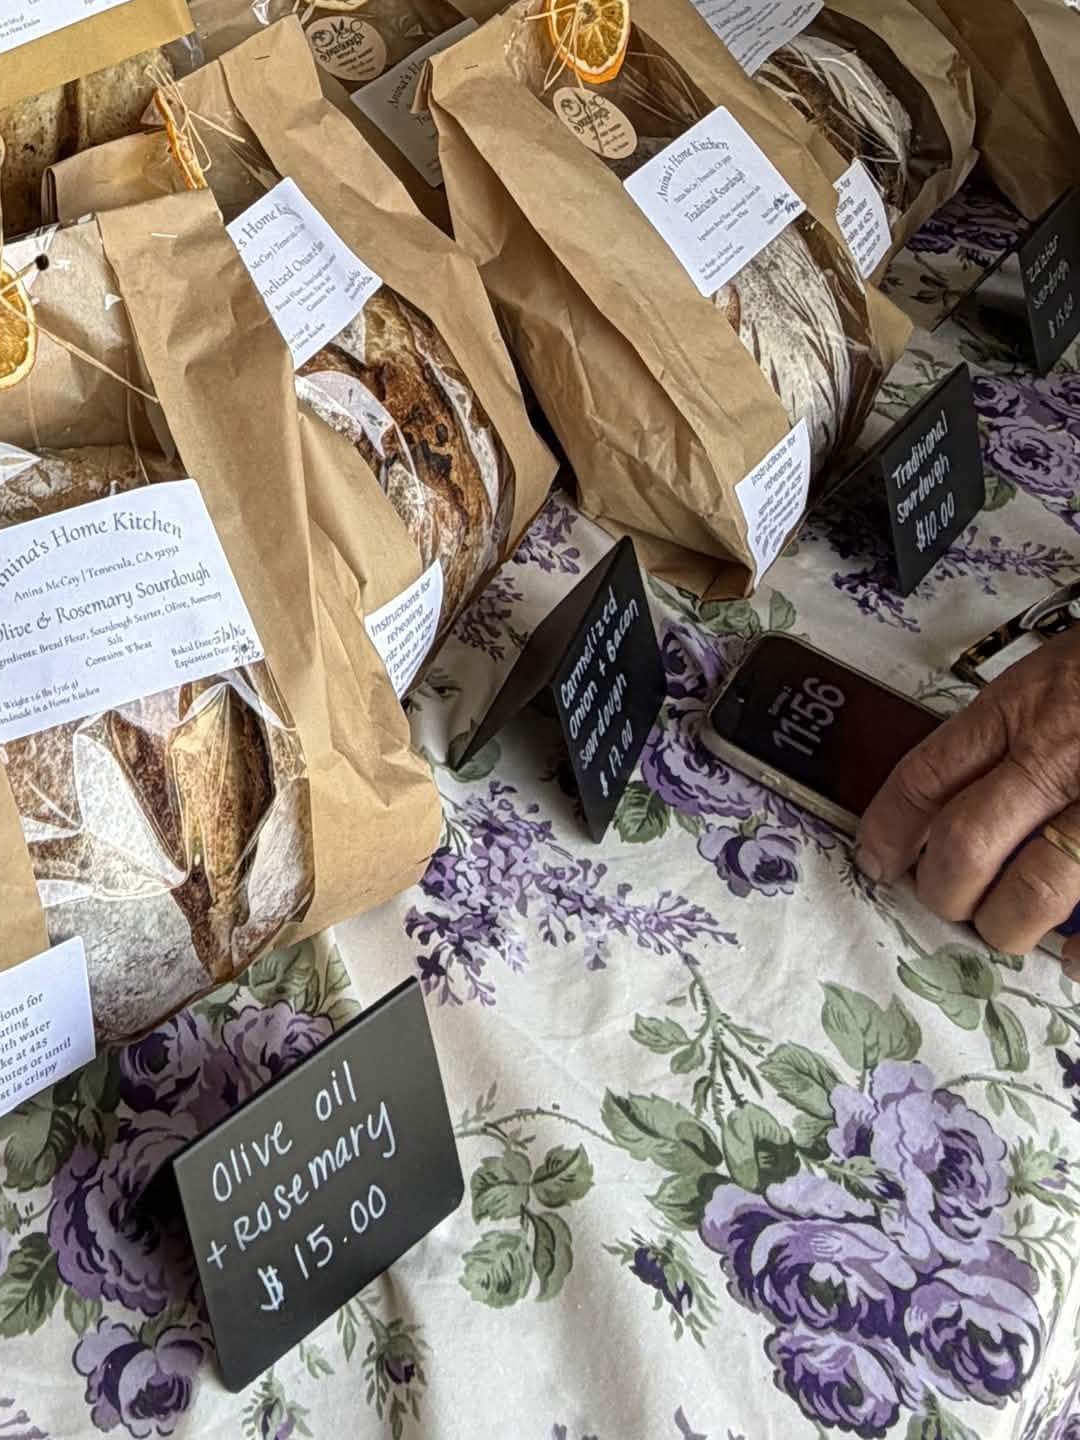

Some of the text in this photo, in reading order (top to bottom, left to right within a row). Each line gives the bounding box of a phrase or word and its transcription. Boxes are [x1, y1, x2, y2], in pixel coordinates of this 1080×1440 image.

[241, 211, 278, 240] Home
[891, 408, 949, 489] Traditional
[50, 519, 108, 548] Home
[113, 510, 183, 539] Kitchen
[14, 586, 44, 603] Anina
[45, 575, 80, 594] McCoy
[135, 551, 154, 565] CA
[36, 611, 52, 630] &
[56, 589, 133, 625] Rosemary
[135, 562, 212, 600] Sourdough
[370, 589, 421, 637] Instructions
[772, 677, 846, 757] 11:56
[26, 991, 45, 1010] for
[15, 1048, 28, 1062] at
[28, 1036, 49, 1053] 425
[19, 1019, 52, 1046] water
[30, 1056, 44, 1070] or
[44, 1036, 73, 1062] until
[12, 1080, 24, 1094] is
[24, 1060, 59, 1088] crispy
[315, 1059, 358, 1122] oil
